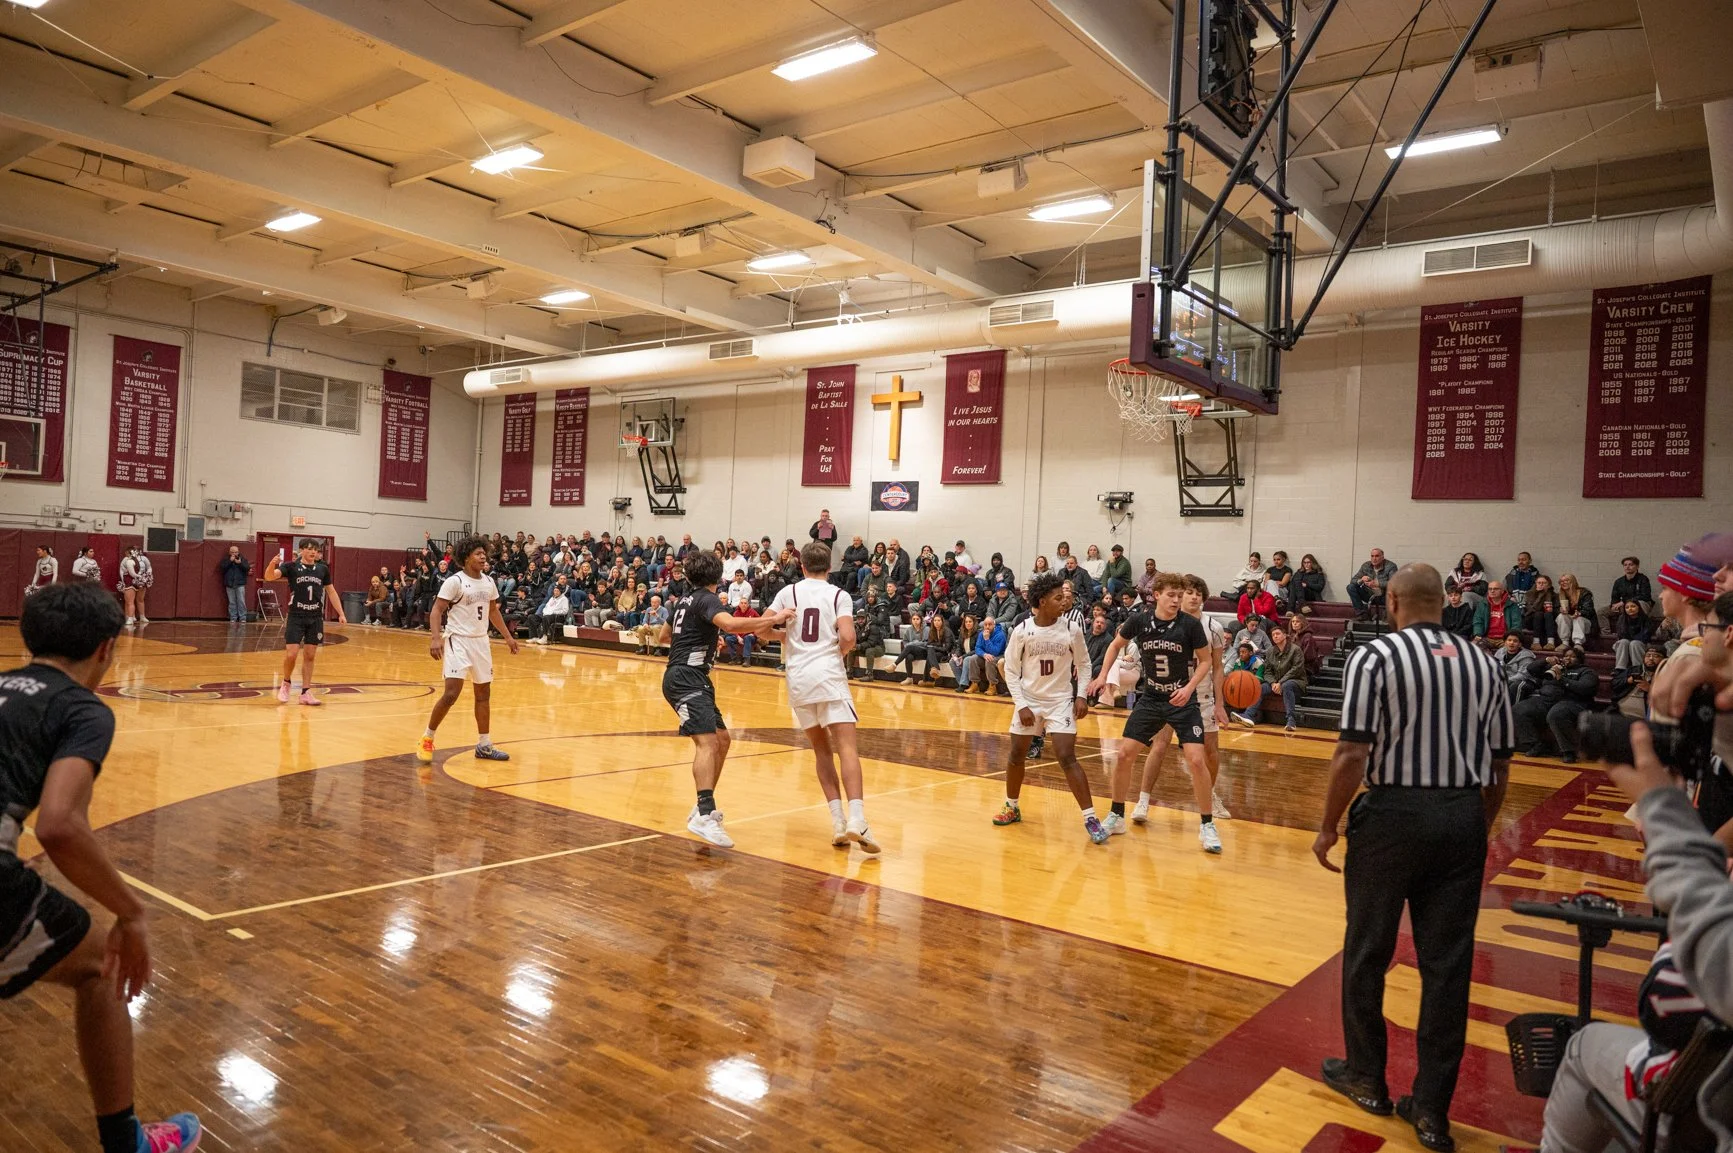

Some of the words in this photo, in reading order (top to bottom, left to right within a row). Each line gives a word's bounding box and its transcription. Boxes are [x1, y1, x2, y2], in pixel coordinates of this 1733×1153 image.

[1607, 306, 1655, 318] VARSITY
[1660, 302, 1693, 314] CREW
[1449, 321, 1490, 332] VARSITY
[1437, 336, 1456, 347] ICE
[1460, 334, 1502, 345] HOCKEY
[0, 349, 45, 363] SUPRMACY
[48, 356, 63, 366] CUP
[133, 368, 160, 380] VARSITY
[125, 377, 167, 390] BASKETBALL
[385, 396, 404, 404] VARSITY
[405, 399, 428, 408] FOOTBALL
[953, 407, 970, 415] LIVE
[973, 417, 998, 425] HEARTS
[952, 465, 986, 474] FOREVER!
[297, 576, 321, 585] ORCHARD
[307, 586, 312, 600] 1
[478, 606, 482, 620] 5
[802, 608, 820, 642] 0
[1143, 640, 1182, 652] ORCHARD
[1040, 660, 1054, 676] 10
[1155, 655, 1170, 677] 3
[1148, 678, 1182, 692] PARK
